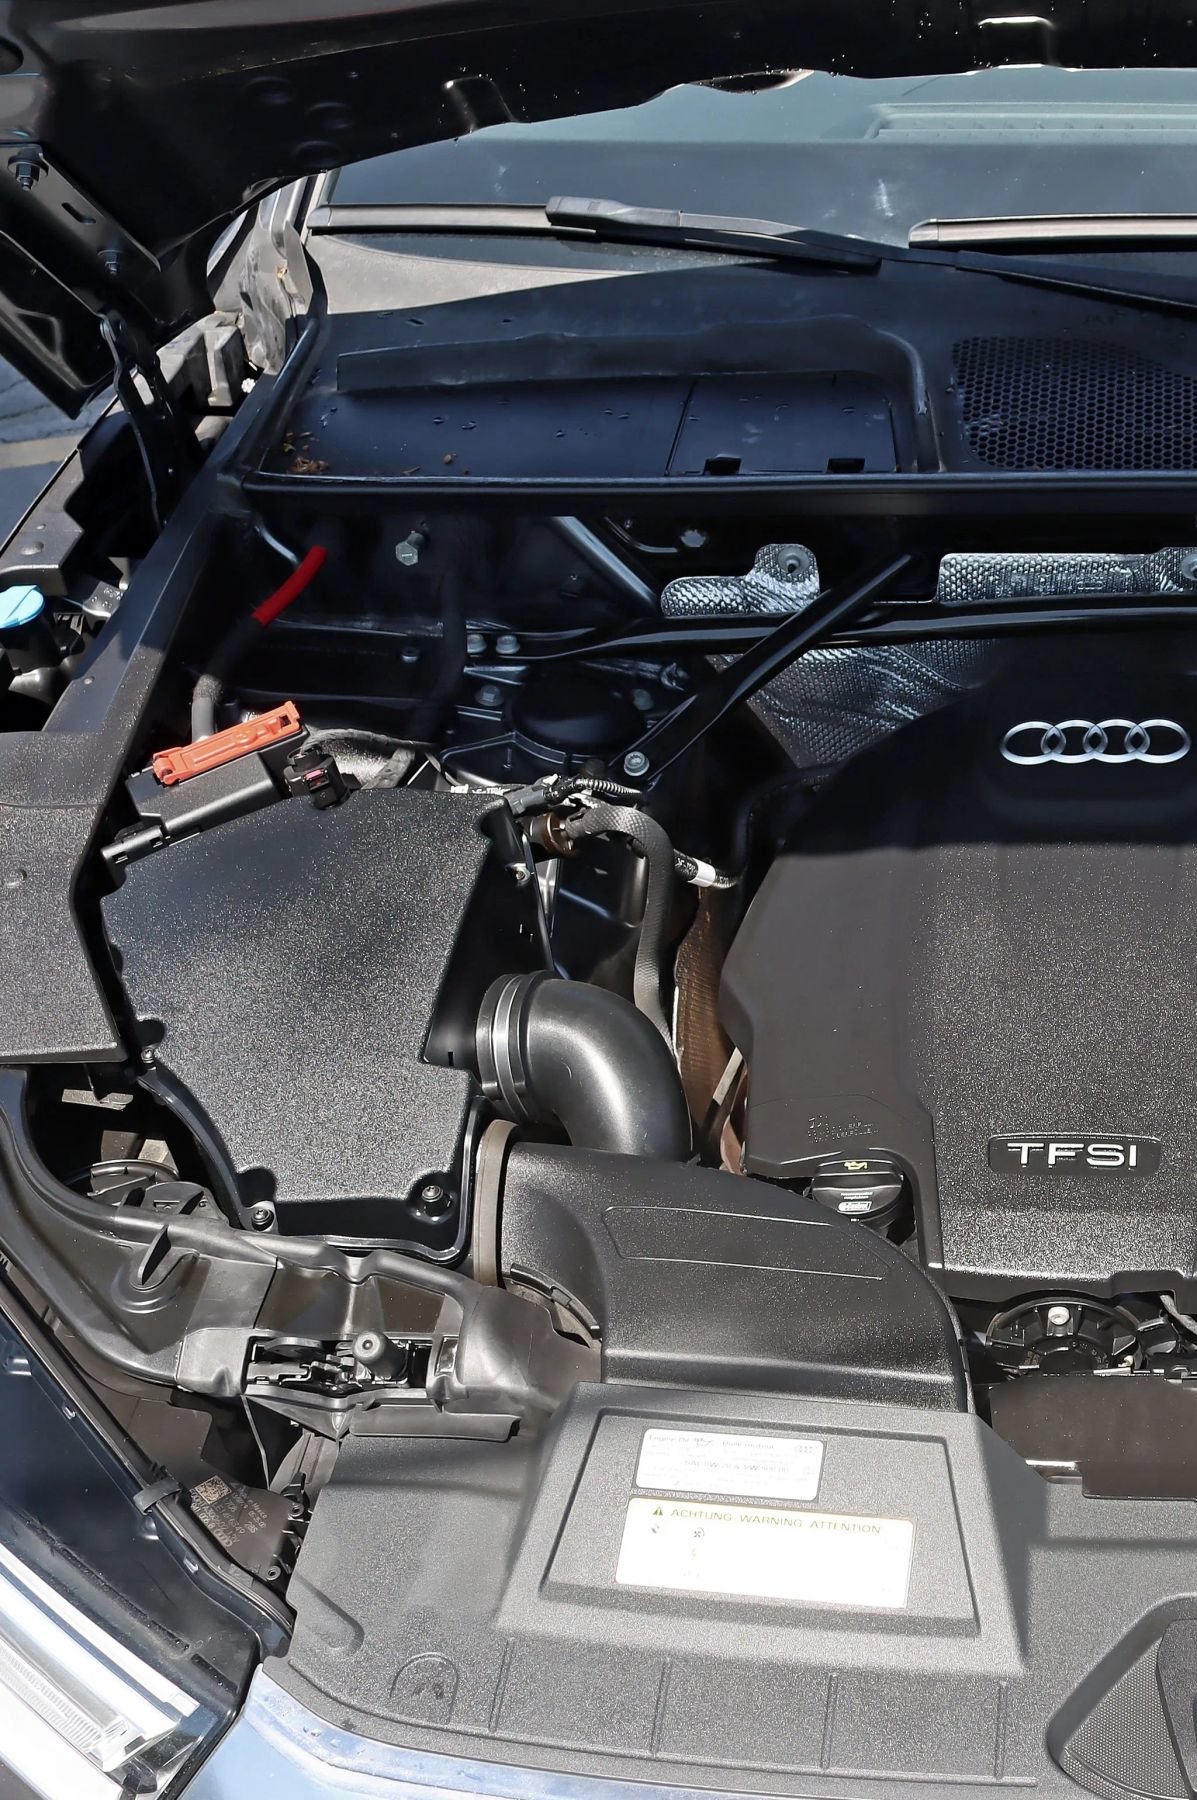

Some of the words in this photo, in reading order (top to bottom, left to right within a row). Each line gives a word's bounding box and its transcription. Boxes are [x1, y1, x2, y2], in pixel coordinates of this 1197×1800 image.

[1007, 1142, 1137, 1167] TFSI
[670, 1508, 732, 1522] ACHTUNG
[739, 1514, 802, 1528] WARNING
[809, 1520, 881, 1534] ATTENTION
